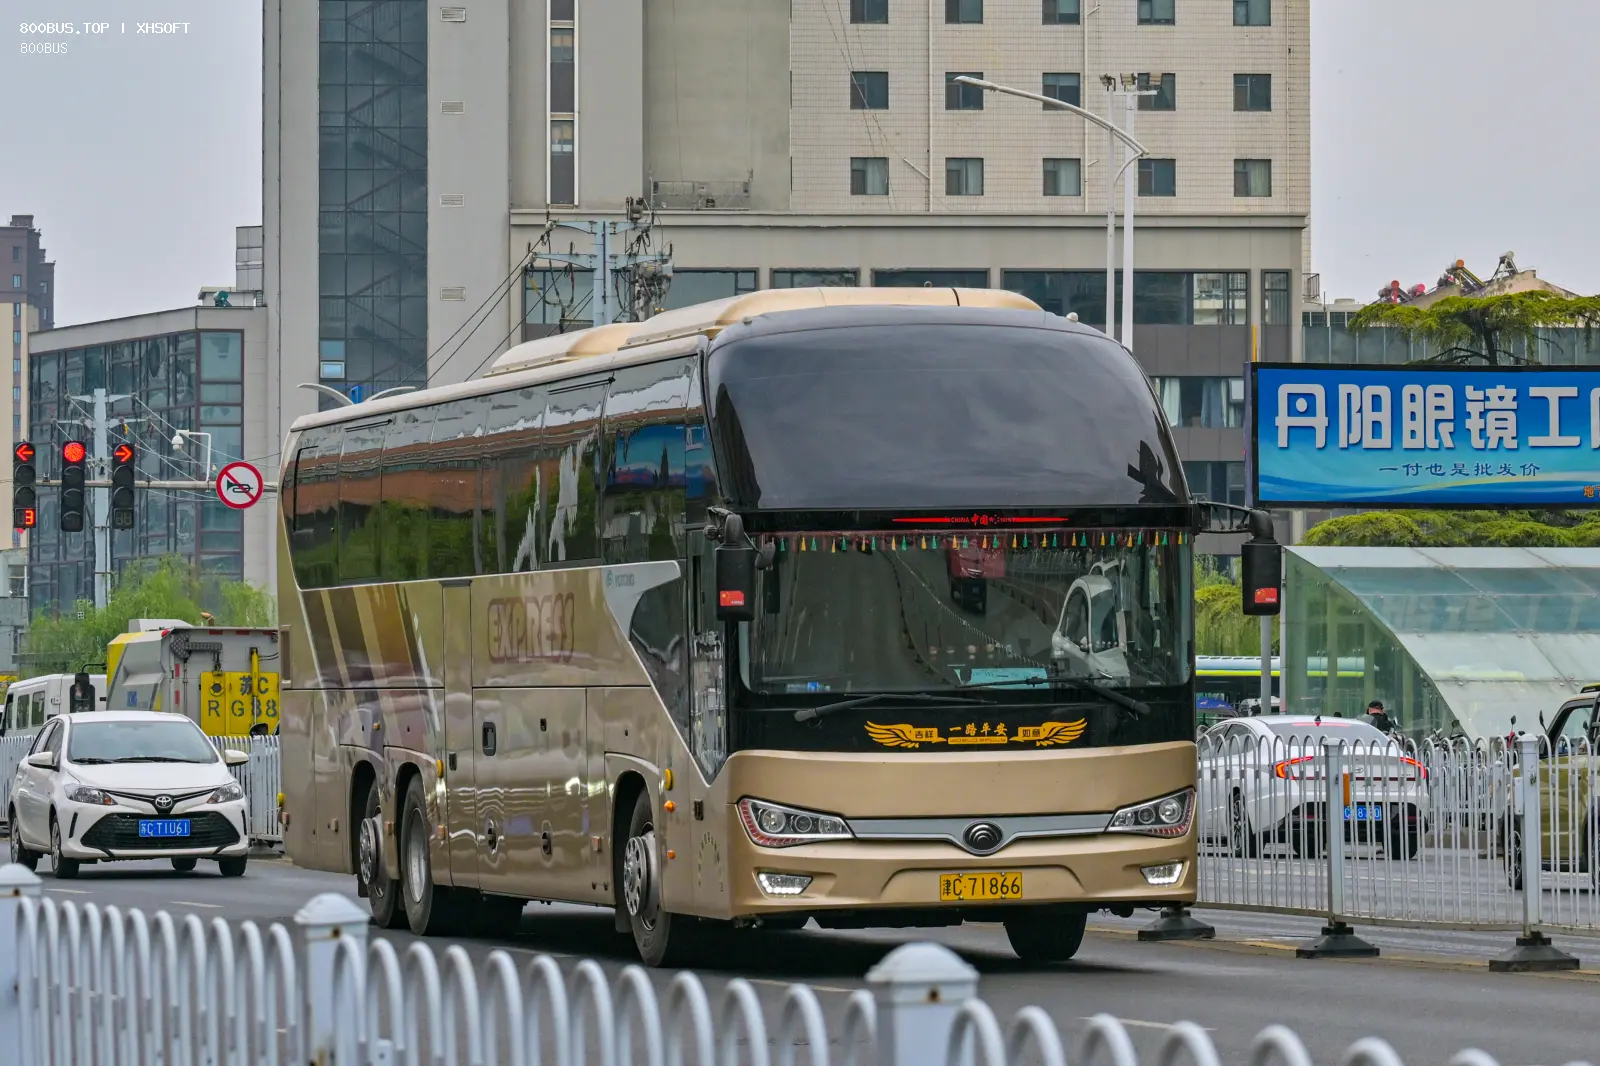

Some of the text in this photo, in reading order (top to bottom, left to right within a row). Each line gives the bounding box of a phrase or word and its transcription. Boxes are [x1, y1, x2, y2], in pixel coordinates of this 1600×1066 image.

[1275, 384, 1600, 449] 丹阳眼镜工
[1378, 462, 1541, 477] 一付也是批发价
[488, 592, 575, 664] EXPRESS
